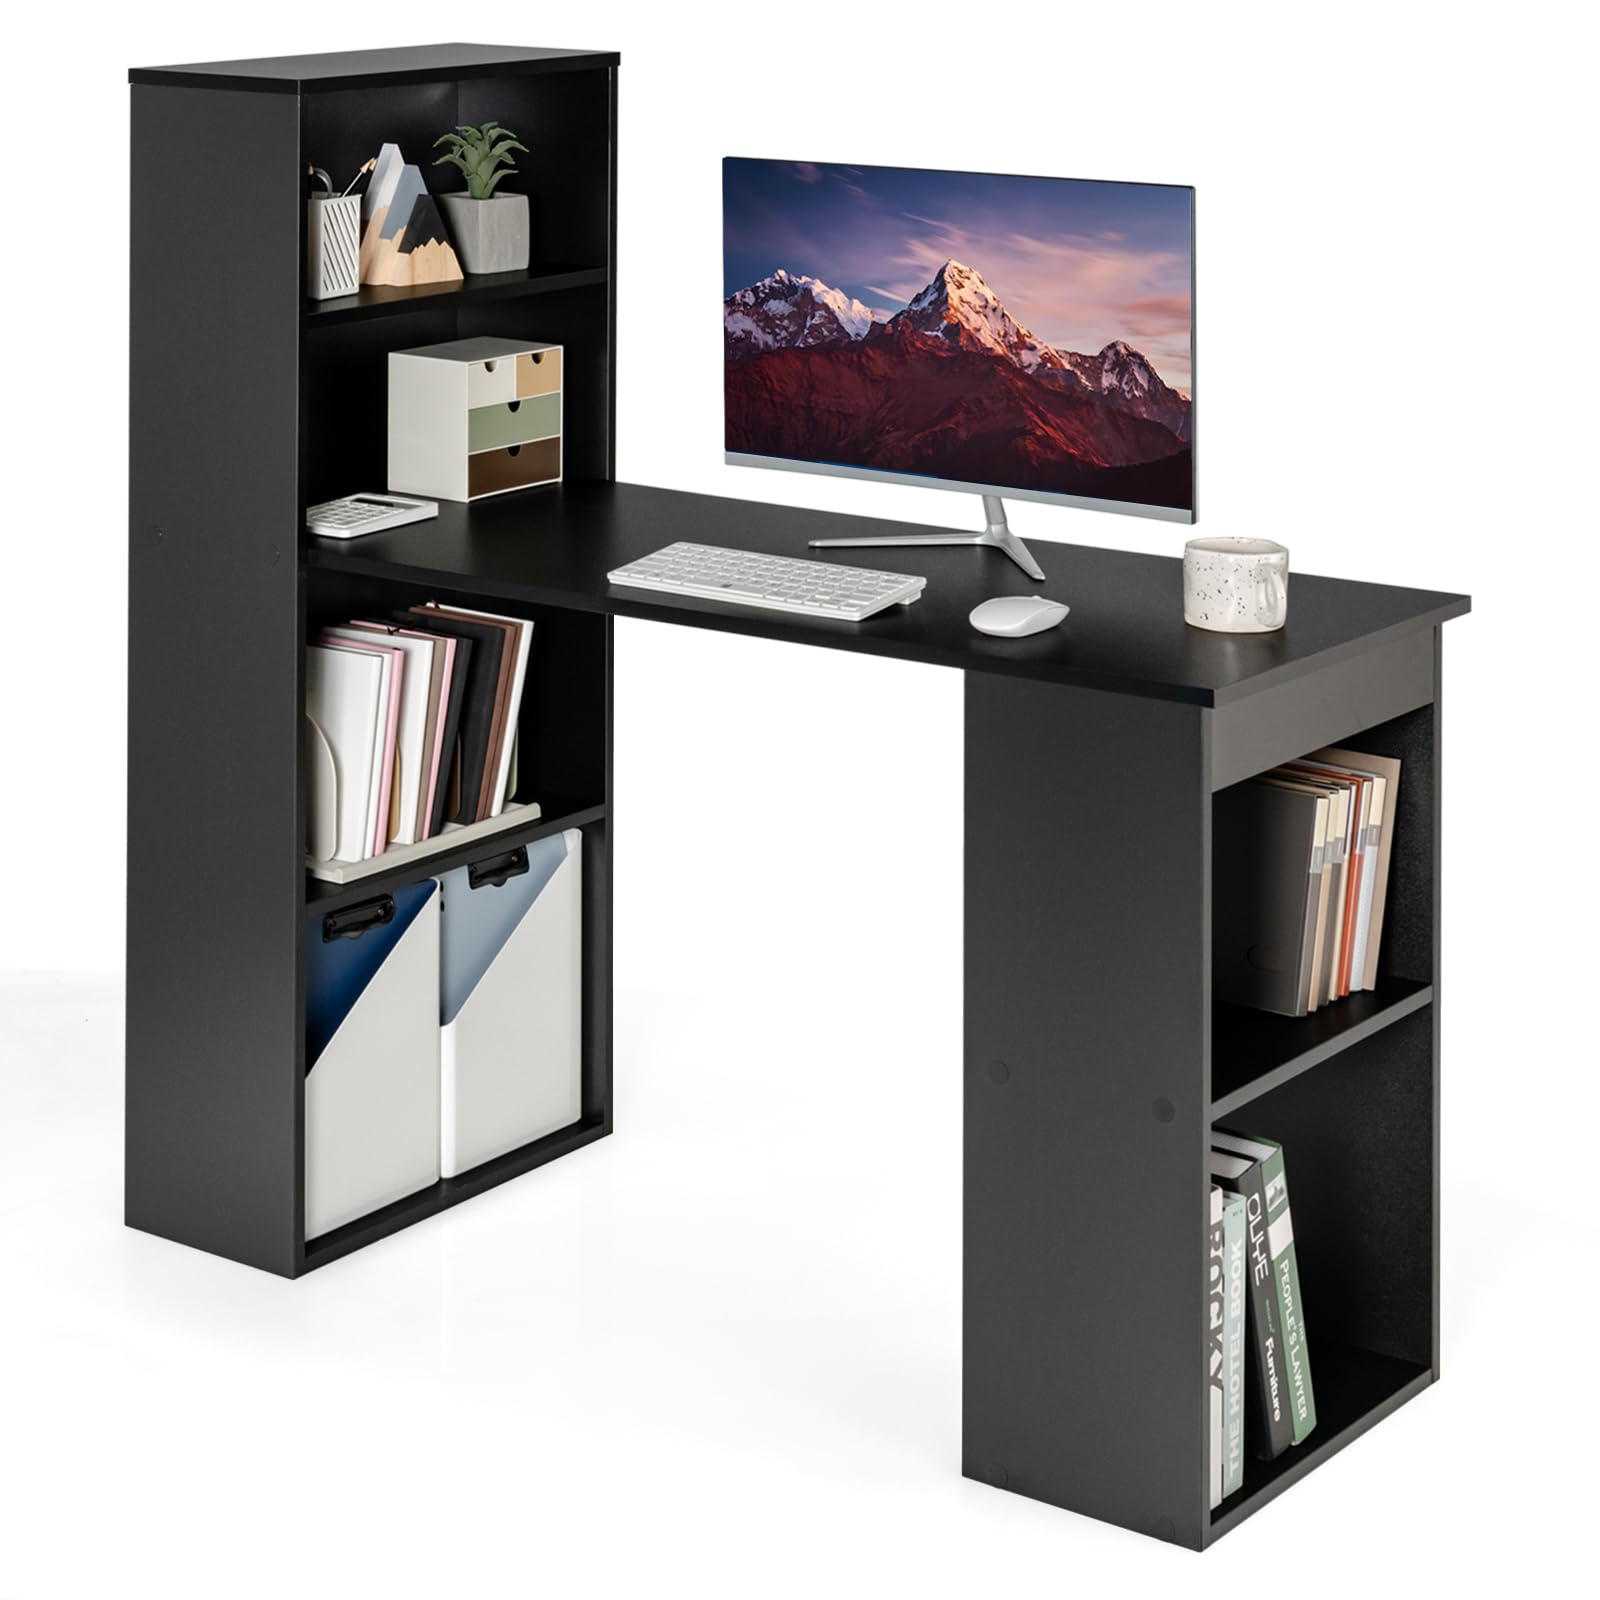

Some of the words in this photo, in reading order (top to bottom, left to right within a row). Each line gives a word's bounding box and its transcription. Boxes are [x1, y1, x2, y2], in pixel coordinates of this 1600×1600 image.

[1231, 1237, 1242, 1318] BOOK
[1230, 1321, 1241, 1416] HOTEL
[1265, 1336, 1281, 1422] Furniture
[1280, 1258, 1297, 1345] PEOPLE'S
[1290, 1345, 1307, 1421] LAWYER
[1230, 1418, 1241, 1479] THE
